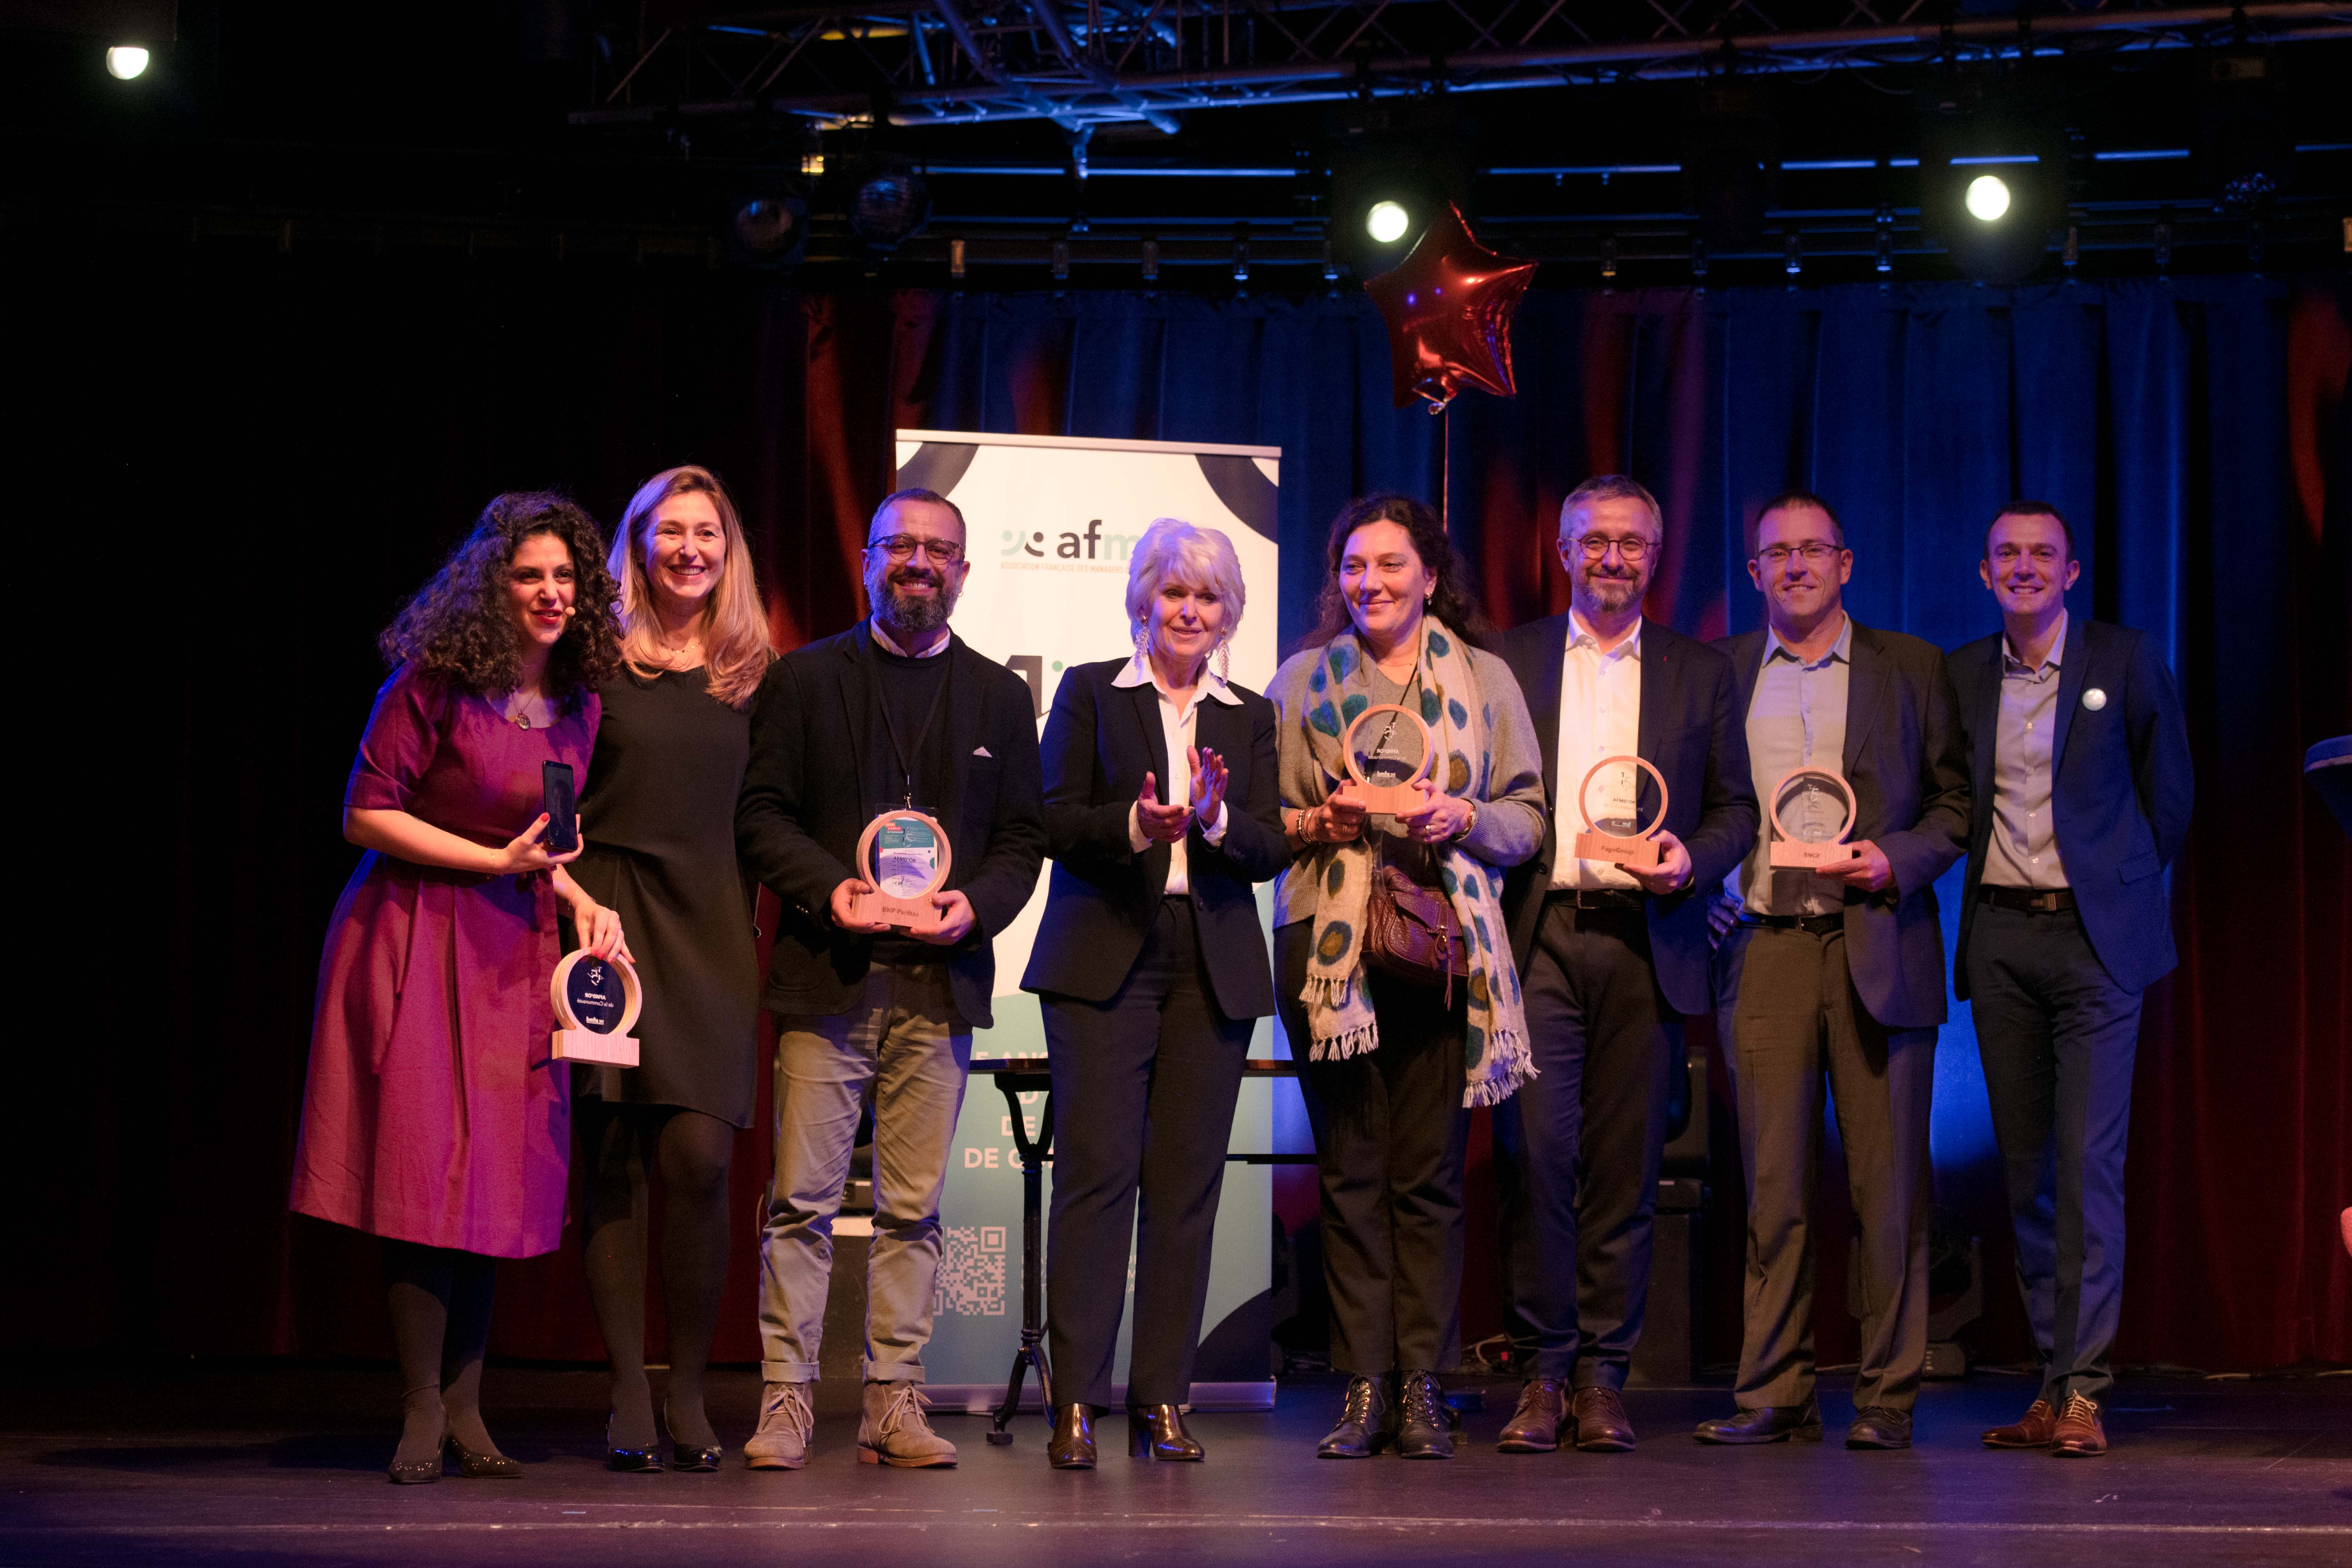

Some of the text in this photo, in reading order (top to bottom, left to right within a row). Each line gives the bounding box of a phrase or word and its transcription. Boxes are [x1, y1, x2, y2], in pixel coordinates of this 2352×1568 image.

[1057, 519, 1141, 560] afm
[1000, 562, 1039, 570] ASSOCIATION
[1041, 563, 1074, 573] FRANÇAISE
[1090, 564, 1123, 573] MANAGERS
[964, 1147, 1000, 1169] DE
